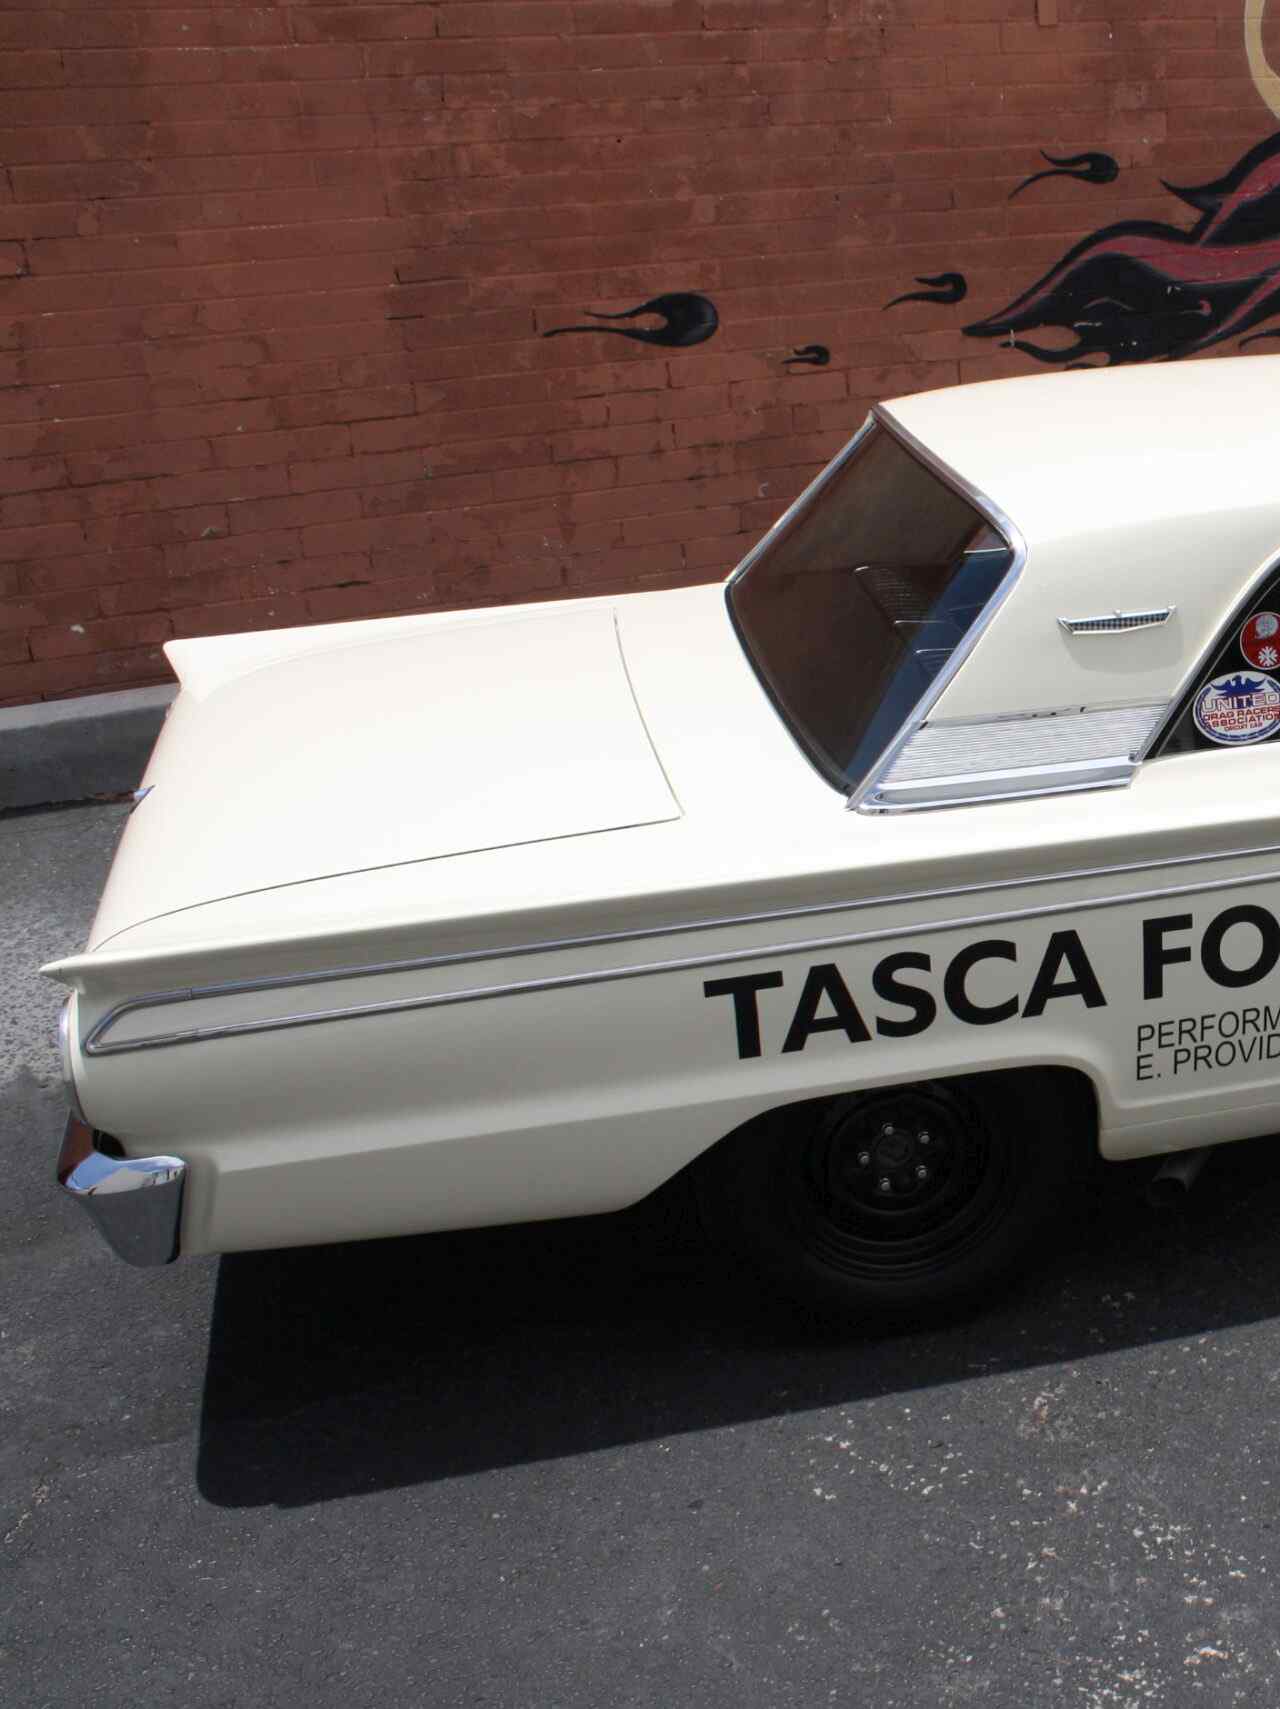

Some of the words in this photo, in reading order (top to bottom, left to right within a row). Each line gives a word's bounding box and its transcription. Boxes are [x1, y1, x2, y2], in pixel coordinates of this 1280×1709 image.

[1201, 692, 1280, 713] UNITED
[1203, 711, 1235, 722] DRAG
[703, 929, 1108, 1060] TASCA
[1136, 1053, 1162, 1081] E.
